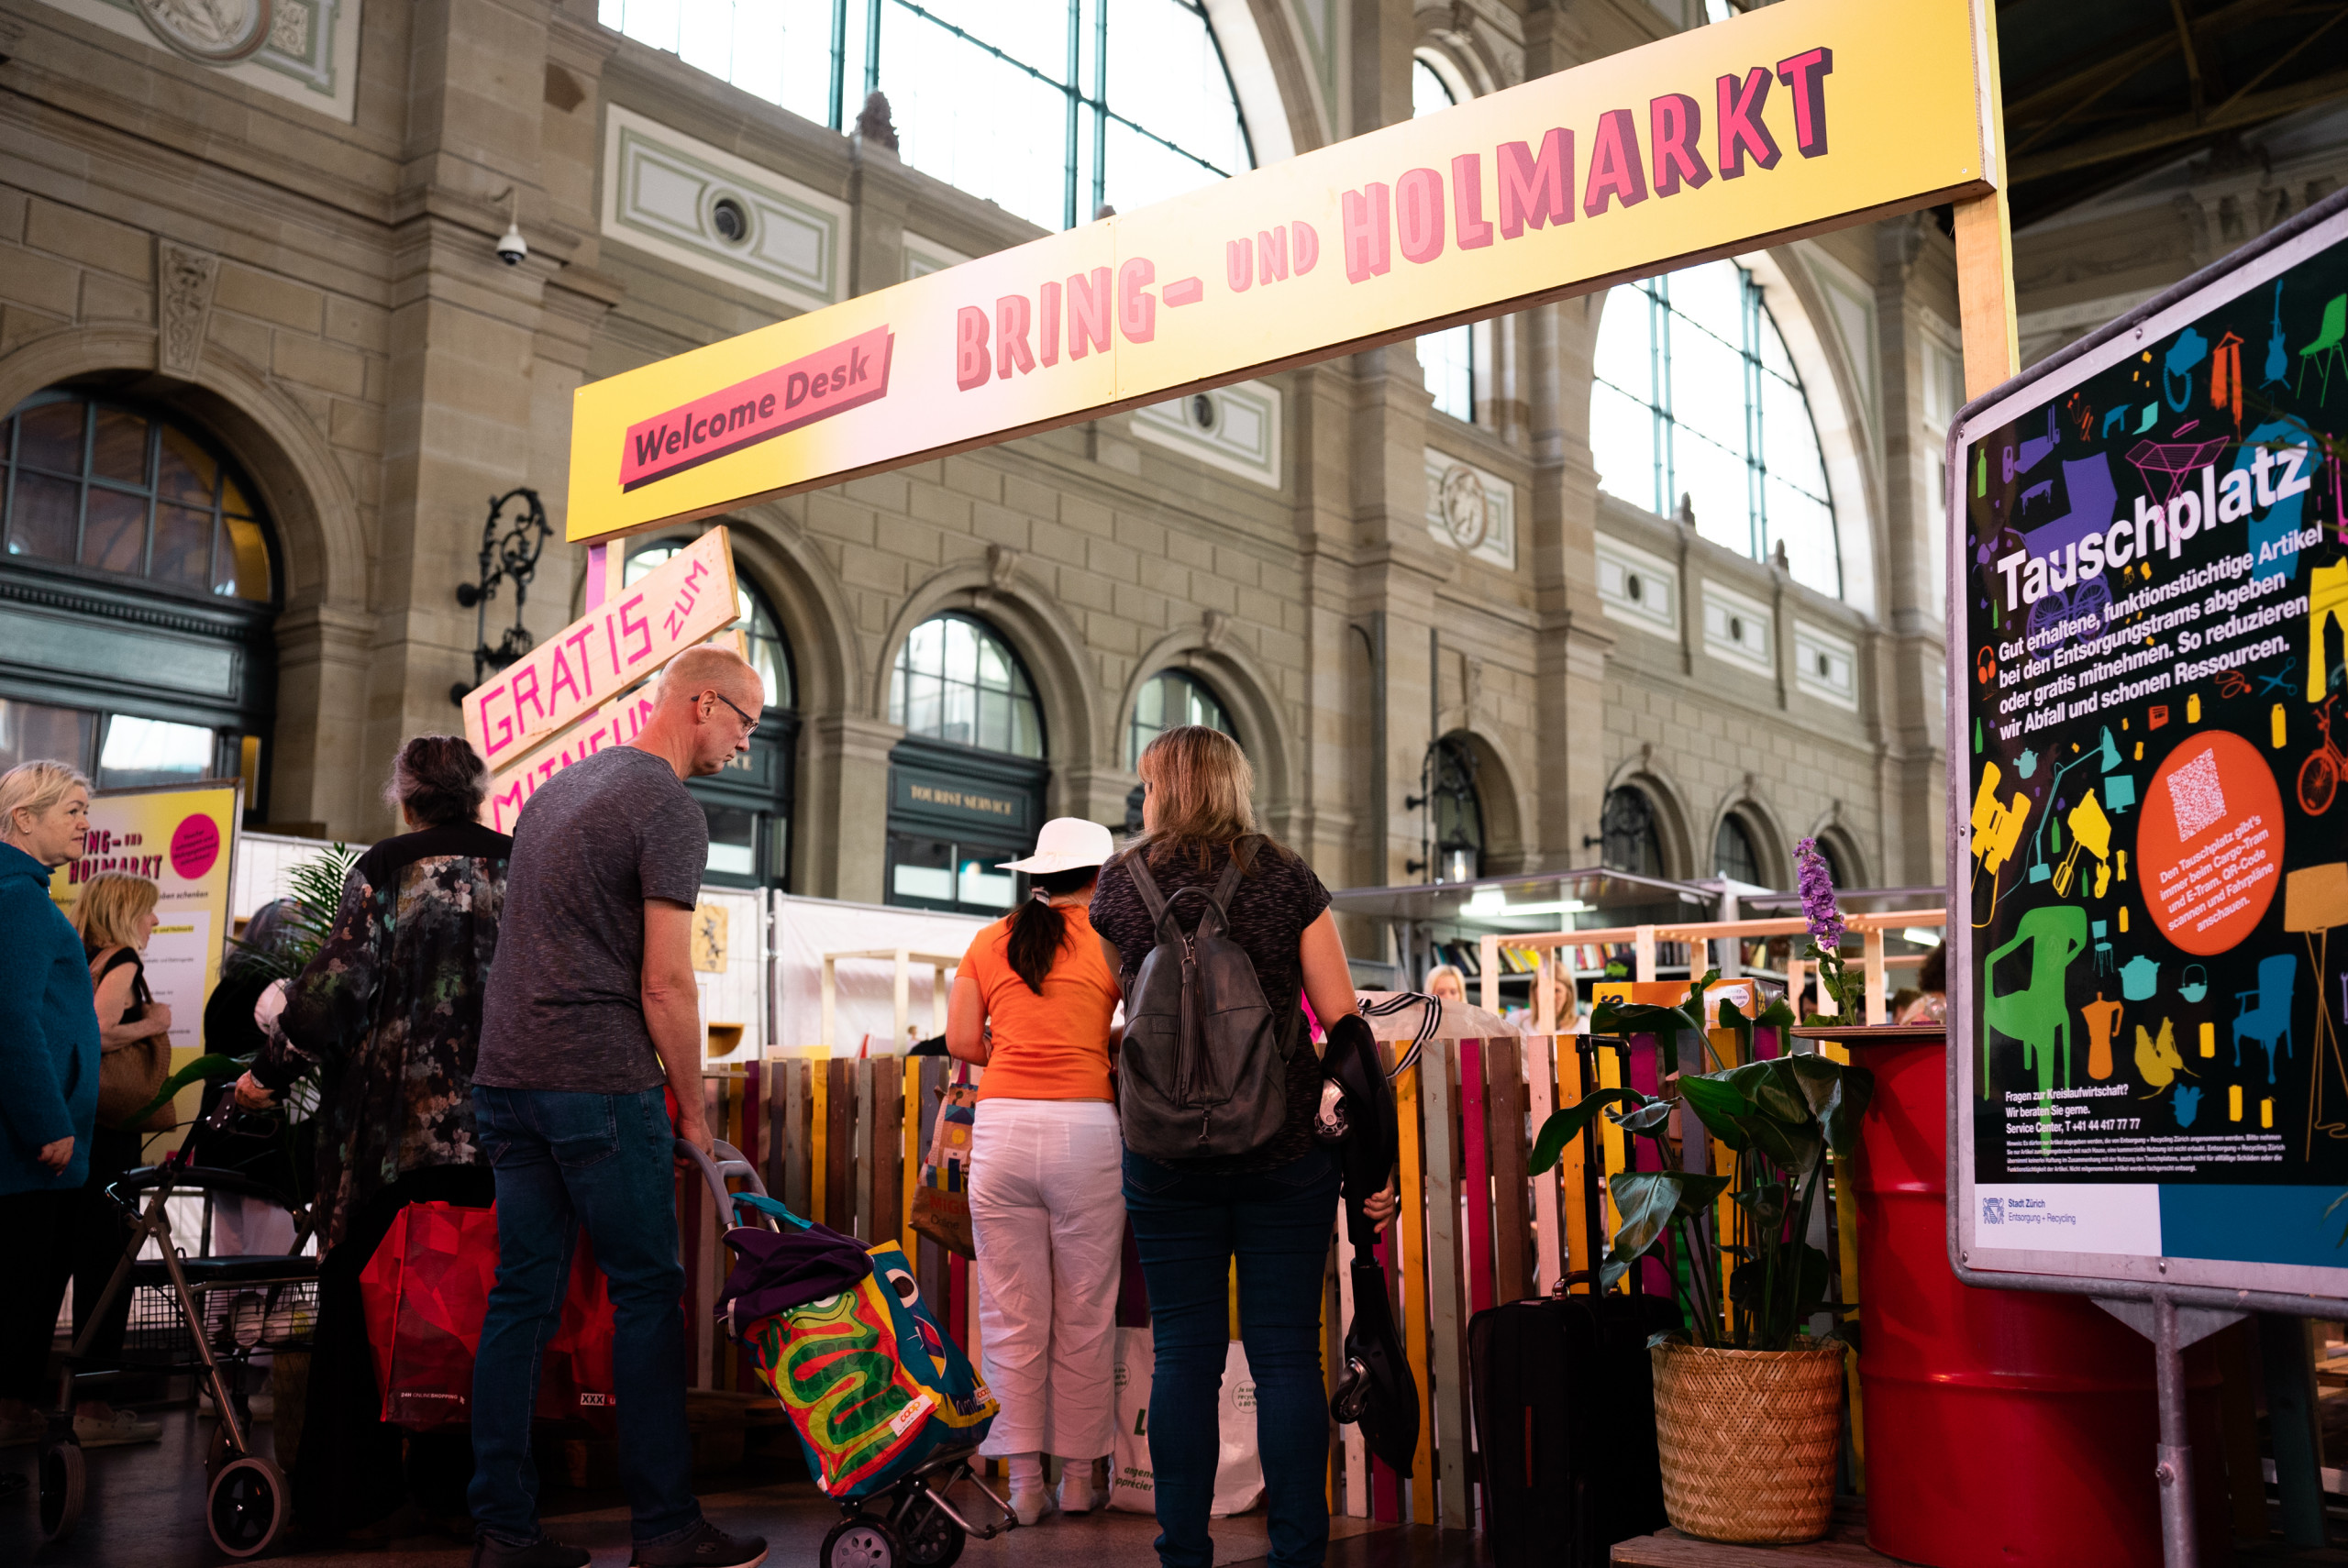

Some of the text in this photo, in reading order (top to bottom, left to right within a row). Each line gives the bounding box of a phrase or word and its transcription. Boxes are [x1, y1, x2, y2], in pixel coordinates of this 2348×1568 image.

[636, 45, 1833, 467] Welcome Desk BRING- UND HOLMARKT
[1997, 440, 2311, 613] Tauschplatz
[1999, 519, 2323, 662] Gut erhaltene, funktionstüchtige Artikel
[480, 559, 709, 758] GRATIS ZUM
[1999, 571, 2286, 689] bei den Entsorgungstrams abgeben
[1999, 595, 2309, 714] oder gratis mitnehmen. So reduzieren
[1999, 635, 2290, 741] wir Abfall und schonen Ressourcen.
[2159, 815, 2262, 884] Den Tauschplatz gibt's
[2160, 828, 2269, 901] immer beim Cargo-Tram
[2167, 849, 2266, 914] und E-Tram. QR-Code
[2167, 863, 2274, 932] scannen und Fahrpläne
[2197, 896, 2251, 933] anschauen.
[2005, 1083, 2129, 1104] Fragen zur Kreislaufwirtschaft?
[2005, 1104, 2090, 1118] Wir beraten Sie gerne.
[2006, 1118, 2141, 1134] Service Center, T +41 44 417 77 77
[2150, 1135, 2174, 1143] Recycling
[2174, 1134, 2190, 1143] Zürich
[2207, 1144, 2237, 1153] Entsorgung
[2241, 1143, 2267, 1153] Recycling
[2267, 1143, 2286, 1151] Zürich
[930, 1195, 969, 1215] MIGR
[2008, 1198, 2046, 1209] Stadt Zürich
[2008, 1211, 2041, 1224] Entsorgung
[2046, 1212, 2077, 1226] Recycling
[901, 1401, 921, 1422] coop
